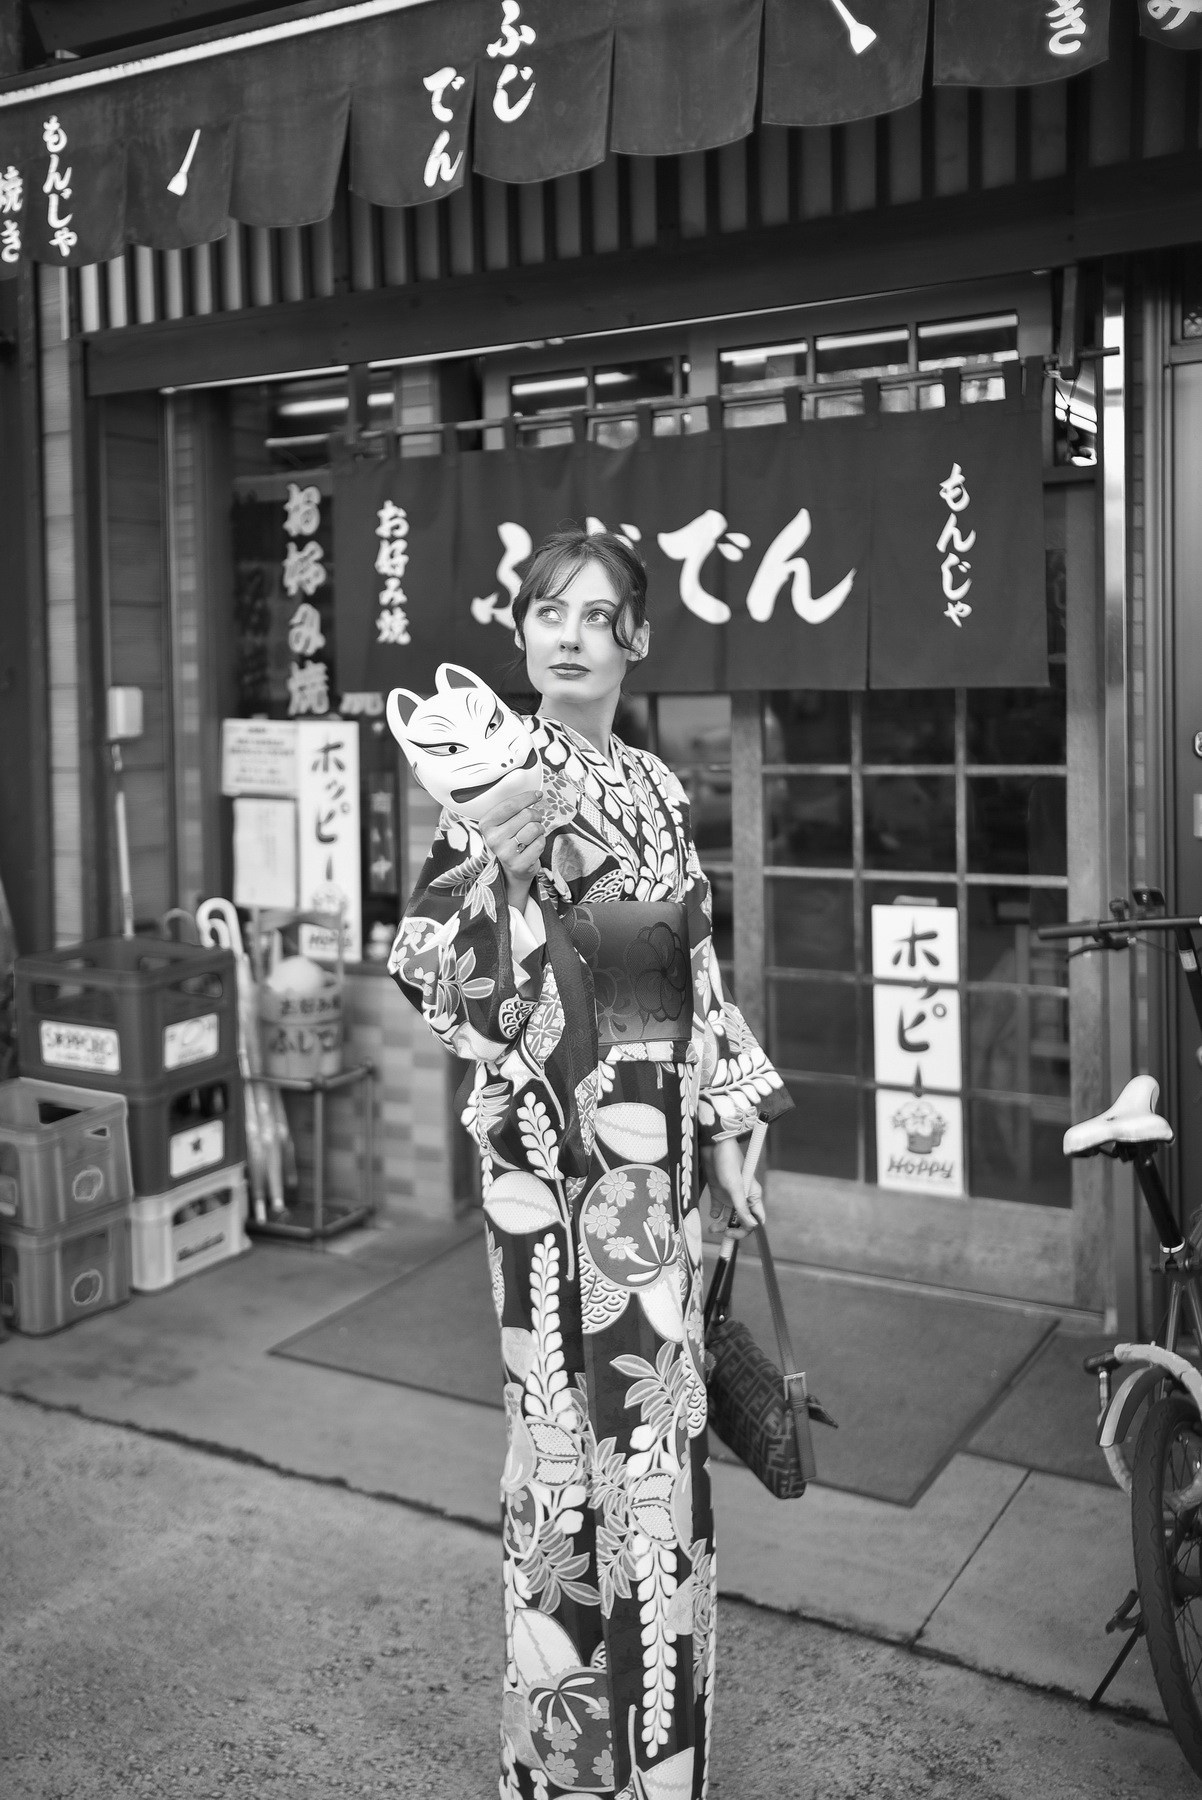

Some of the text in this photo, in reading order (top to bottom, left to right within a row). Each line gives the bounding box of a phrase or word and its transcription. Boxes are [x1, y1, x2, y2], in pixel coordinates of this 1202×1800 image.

[422, 66, 466, 188] でん
[471, 508, 857, 630] ふでん
[886, 1152, 955, 1180] Hoppy
